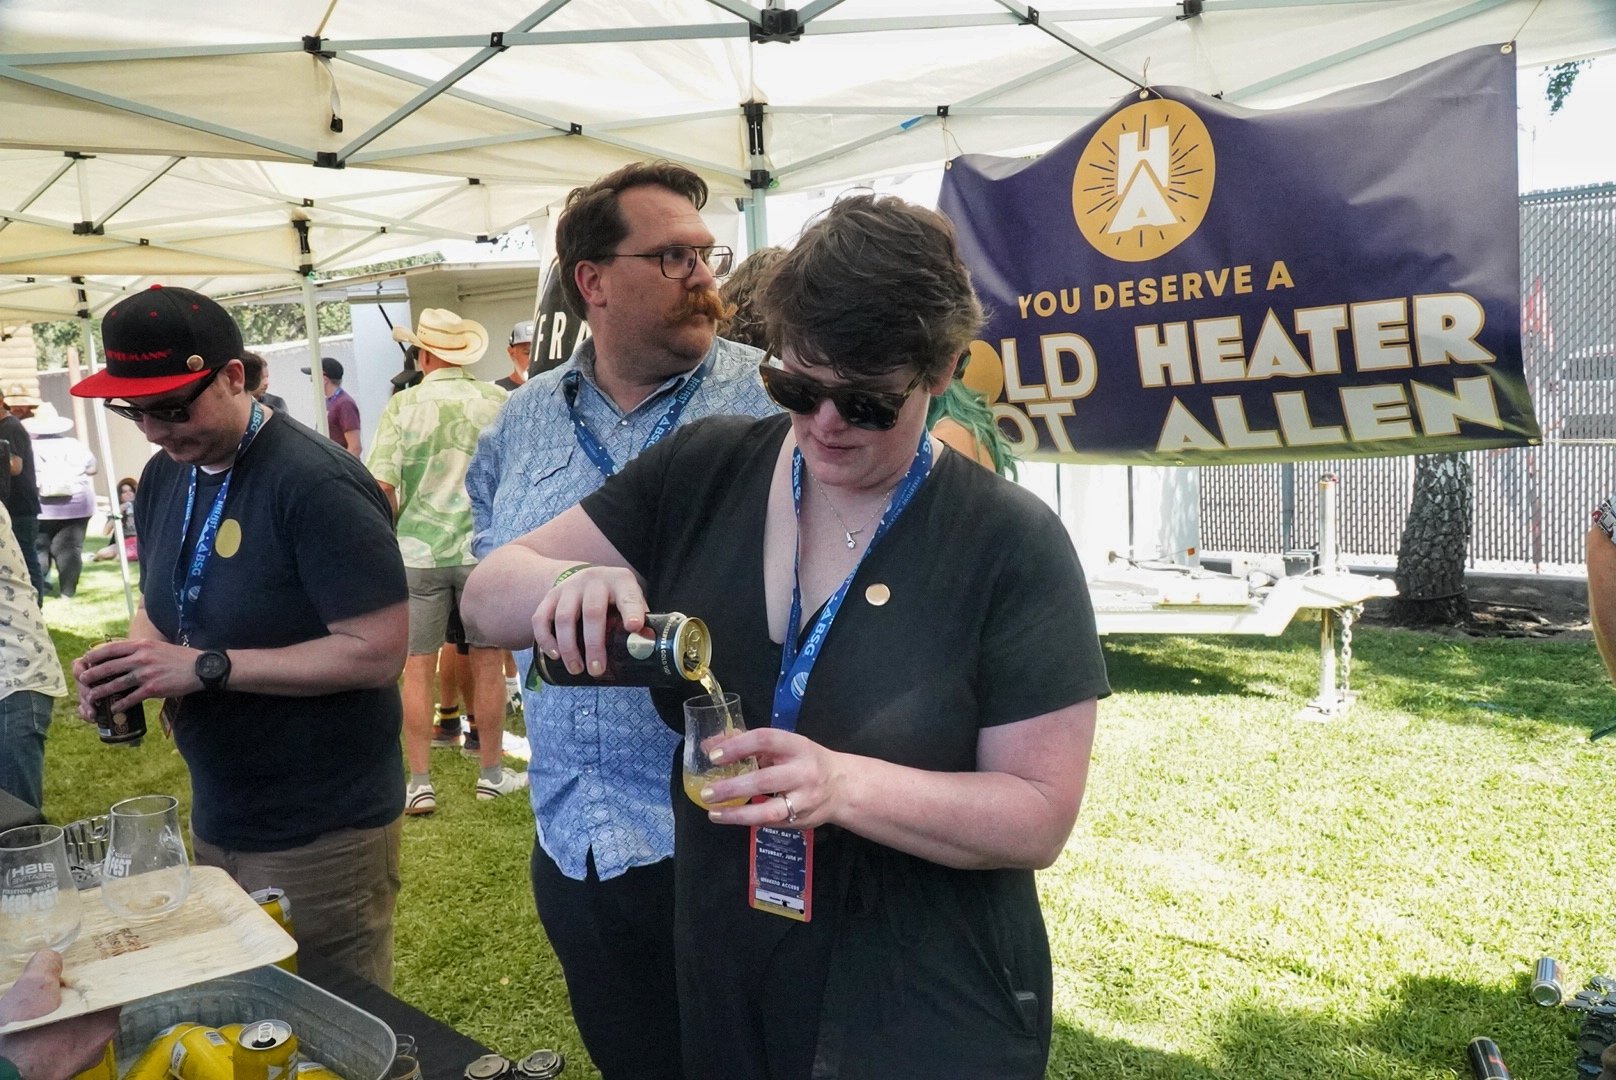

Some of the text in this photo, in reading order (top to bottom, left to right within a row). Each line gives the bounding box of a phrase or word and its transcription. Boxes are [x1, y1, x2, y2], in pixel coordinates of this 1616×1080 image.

[1018, 260, 1295, 319] YOU DESERVE A
[1135, 291, 1496, 389] HEATER
[991, 400, 1080, 455] OT
[1156, 375, 1504, 453] ALLEN
